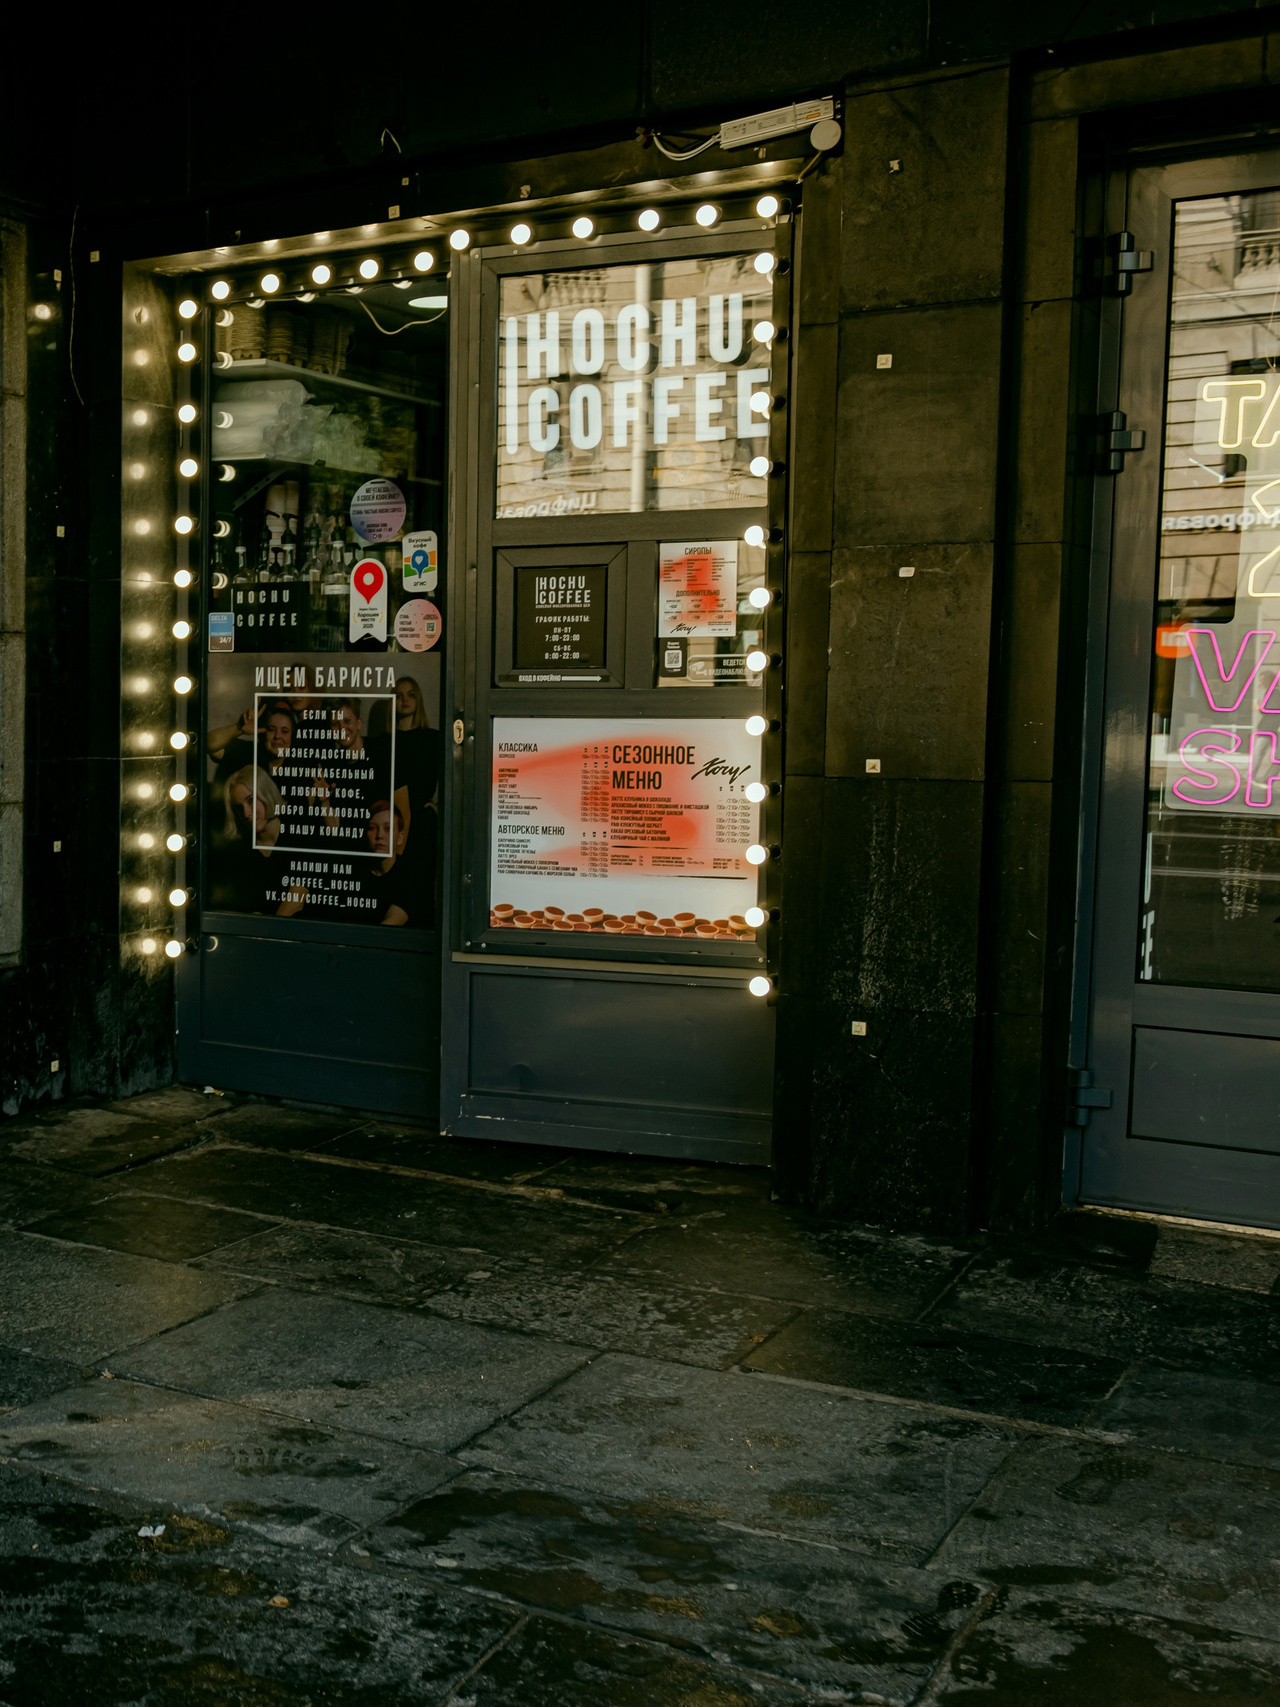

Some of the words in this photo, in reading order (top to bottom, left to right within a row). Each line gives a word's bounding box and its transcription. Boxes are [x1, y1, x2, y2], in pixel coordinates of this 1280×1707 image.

[526, 292, 743, 379] HOCHU
[528, 368, 770, 452] COFFEE
[408, 536, 432, 544] Вкусный
[684, 547, 712, 555] СИРОПЫ
[540, 575, 586, 590] HOCHU
[236, 589, 290, 604] HOCHU
[539, 590, 591, 604] COFFEE
[236, 612, 297, 627] COFFEE
[562, 615, 590, 623] РАБОТЫ:
[255, 666, 306, 689] ИЩЕМ
[315, 666, 396, 688] БАРИСТА
[537, 674, 561, 682] КОФЕЙНЮ
[303, 709, 327, 720] ЕСЛИ
[332, 710, 344, 721] ТЫ
[296, 728, 351, 741] АКТИВНЫЙ,
[277, 746, 370, 761] ЖИЗНЕРАДОСТНЫЙ,
[498, 743, 538, 752] КЛАССИКА
[613, 745, 695, 765] СЕЗОННОЕ
[272, 766, 375, 780] КОММУНИКАБЕЛЬНЫЙ
[612, 771, 662, 790] МЕНЮ
[281, 785, 286, 796] И
[290, 786, 331, 798] ЛЮБИШЬ
[335, 787, 364, 800] КОФЕ,
[274, 804, 304, 816] ДОБРО
[308, 806, 371, 819] ПОЖАЛОВАТЬ
[280, 823, 285, 834] В
[290, 825, 315, 836] НАШУ
[320, 826, 364, 839] КОМАНДУ
[497, 825, 540, 835] АВТОРСКОЕ
[541, 826, 565, 836] МЕНЮ
[290, 860, 328, 874] НАПИШИ
[333, 863, 352, 875] НАМ
[281, 876, 361, 892] @COFFEE_HOCHU
[265, 890, 377, 909] VK.COM/COFFEE_HOCHU
